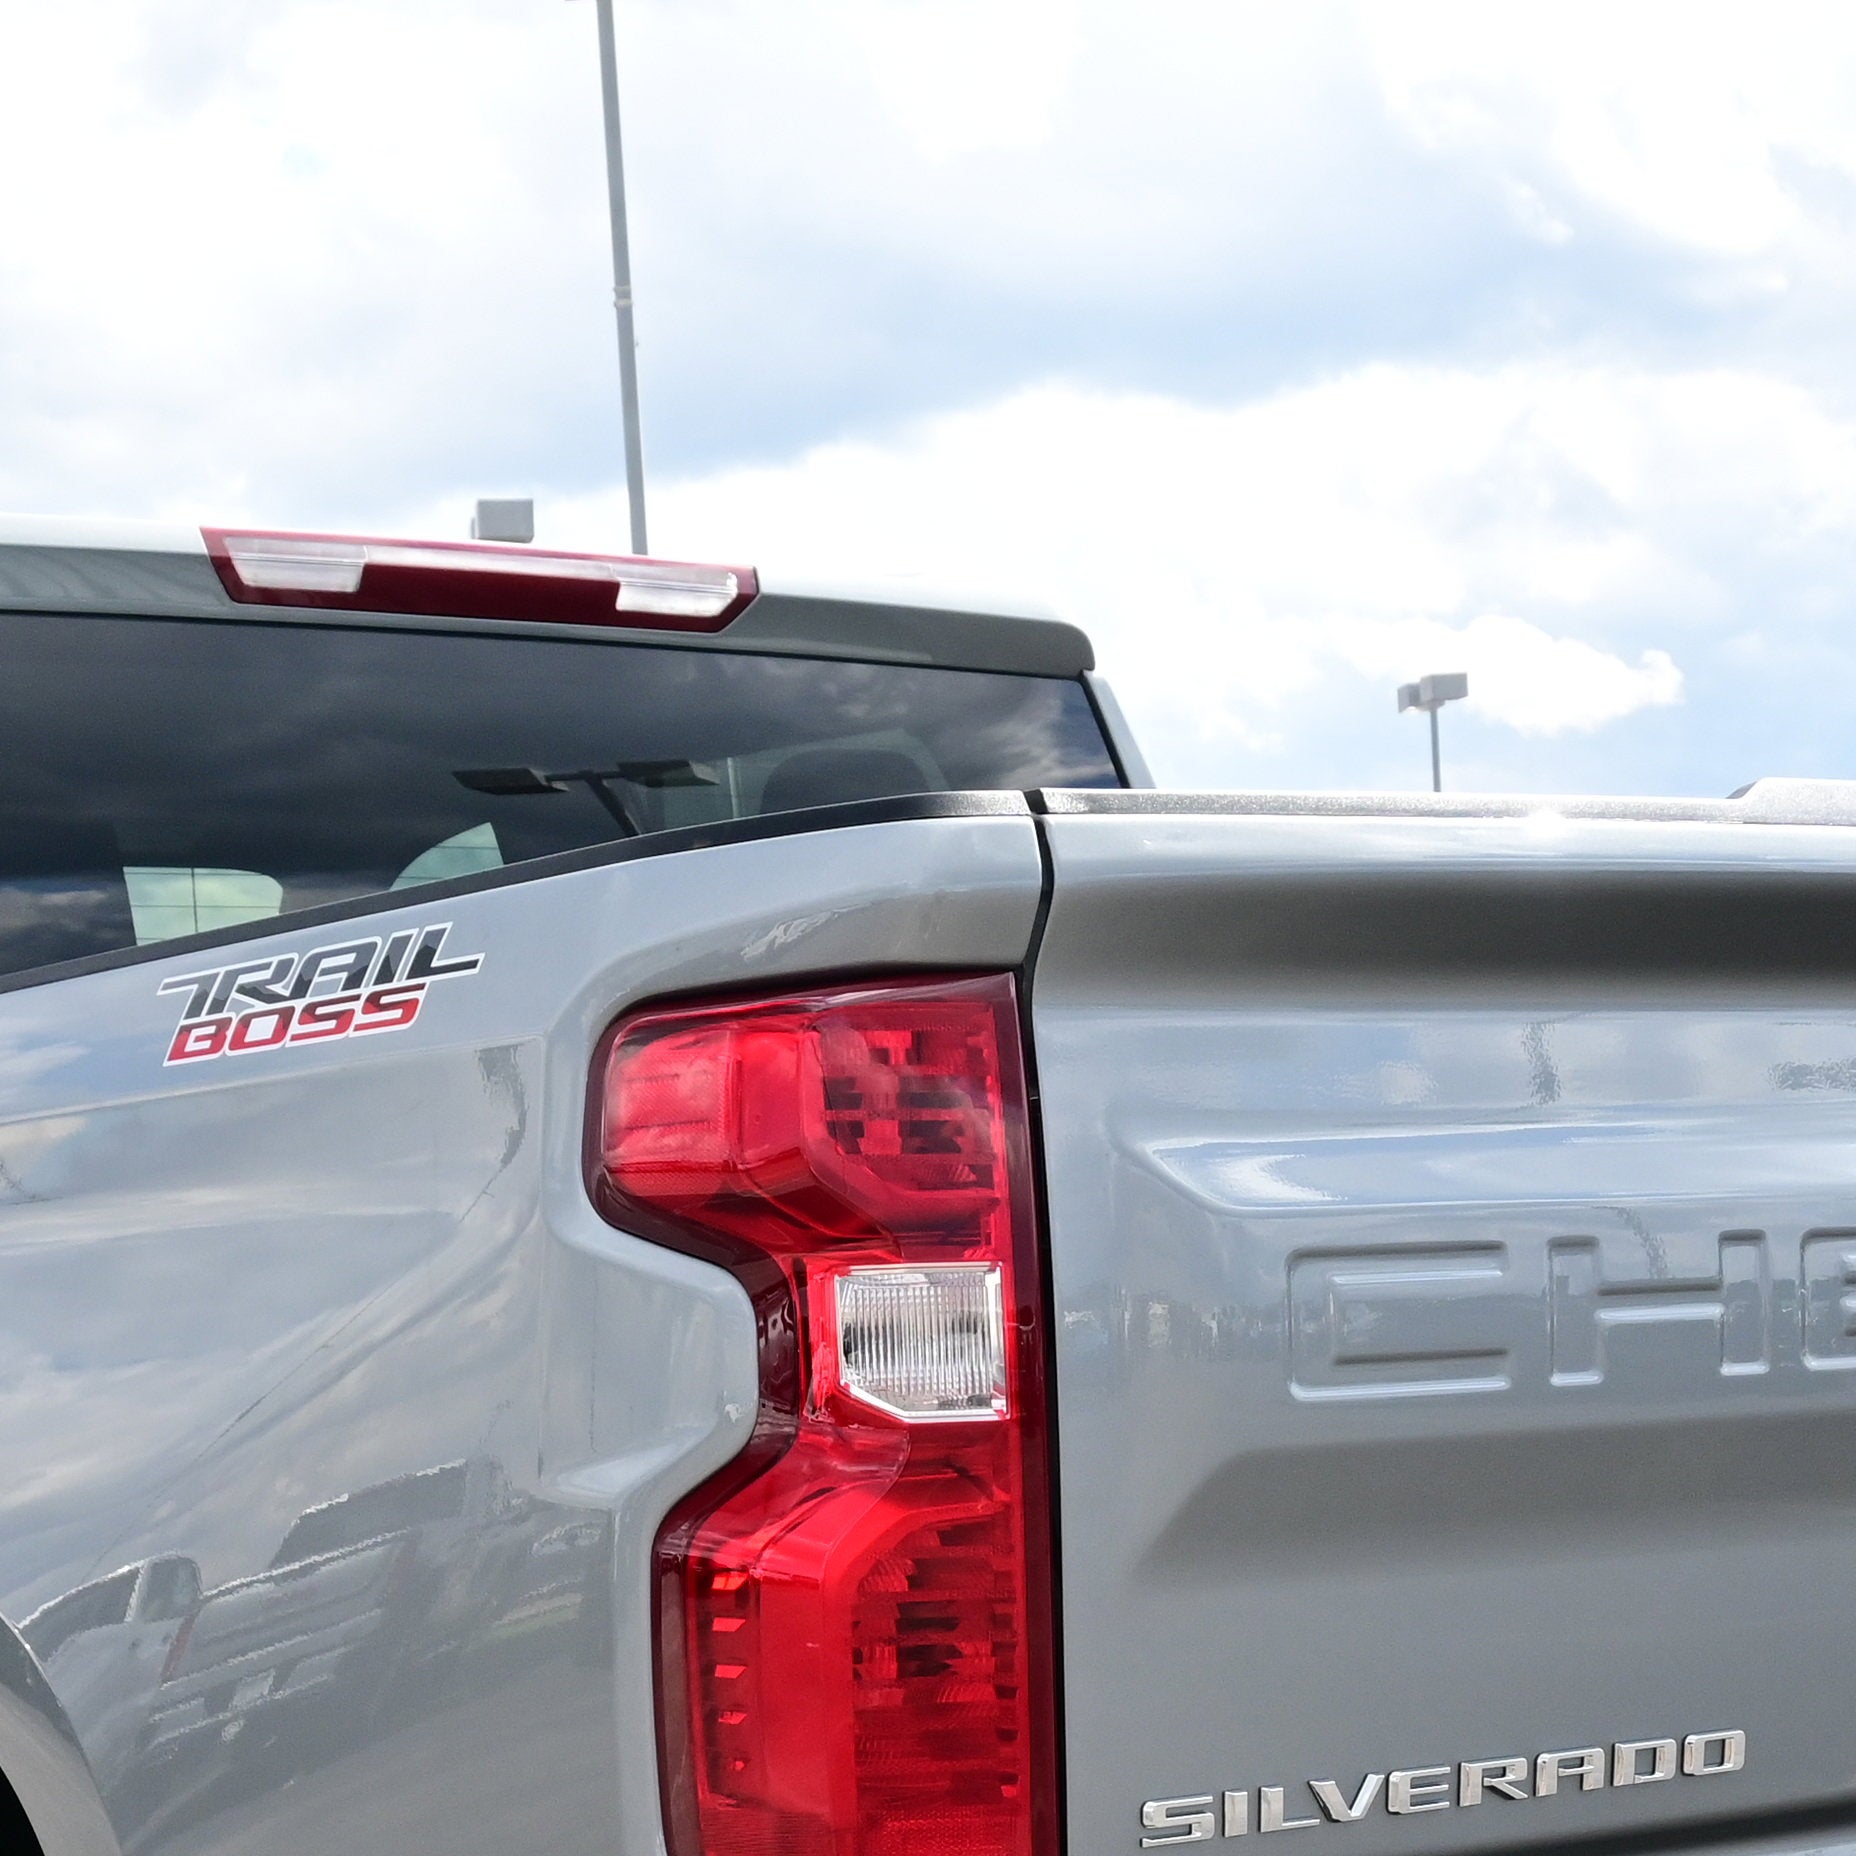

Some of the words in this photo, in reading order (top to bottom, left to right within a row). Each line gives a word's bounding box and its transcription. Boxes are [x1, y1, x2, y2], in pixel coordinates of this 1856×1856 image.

[156, 921, 485, 1020] TRAIL
[163, 982, 431, 1066] BOSS
[1138, 1729, 1746, 1848] SILVERADO
